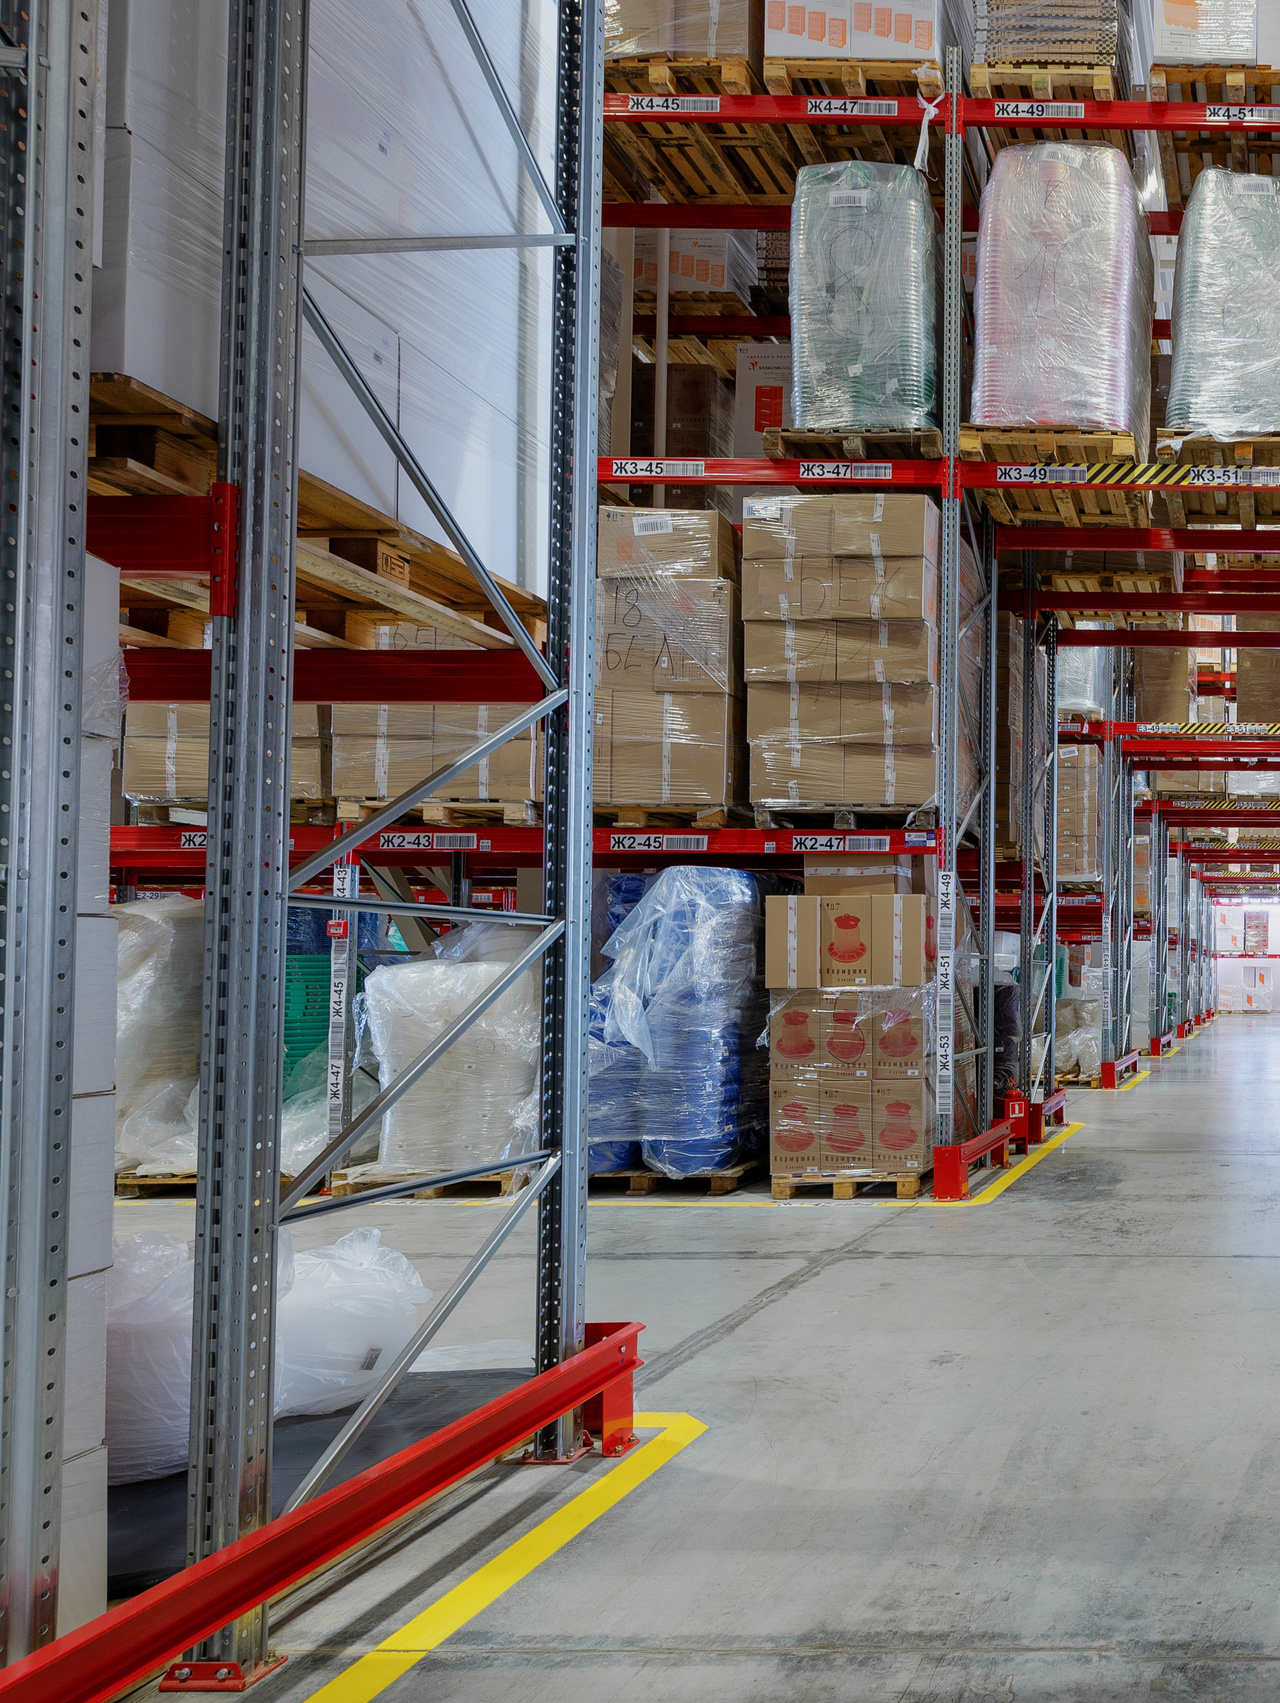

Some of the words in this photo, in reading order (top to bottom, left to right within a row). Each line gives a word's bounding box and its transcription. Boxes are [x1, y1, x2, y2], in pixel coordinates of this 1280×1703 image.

[629, 97, 680, 111] Ж4-45
[808, 100, 858, 114] Ж4-47
[995, 103, 1045, 117] Ж4-49
[1207, 106, 1255, 120] Ж4-51
[613, 461, 663, 475] Ж3-45
[801, 463, 851, 478] Ж3-47
[998, 466, 1047, 480] Ж3-49
[1190, 468, 1240, 482] Ж3-51
[613, 585, 642, 628] 18
[380, 833, 431, 848] Ж2-43
[611, 836, 662, 850] Ж2-45
[793, 837, 843, 851] Ж2-47
[940, 874, 951, 910] Ж4-49
[940, 955, 951, 990] Ж4-51
[332, 981, 344, 1018] Ж4-45
[940, 1035, 951, 1072] Ж4-53
[330, 1064, 342, 1100] Ж4-47
